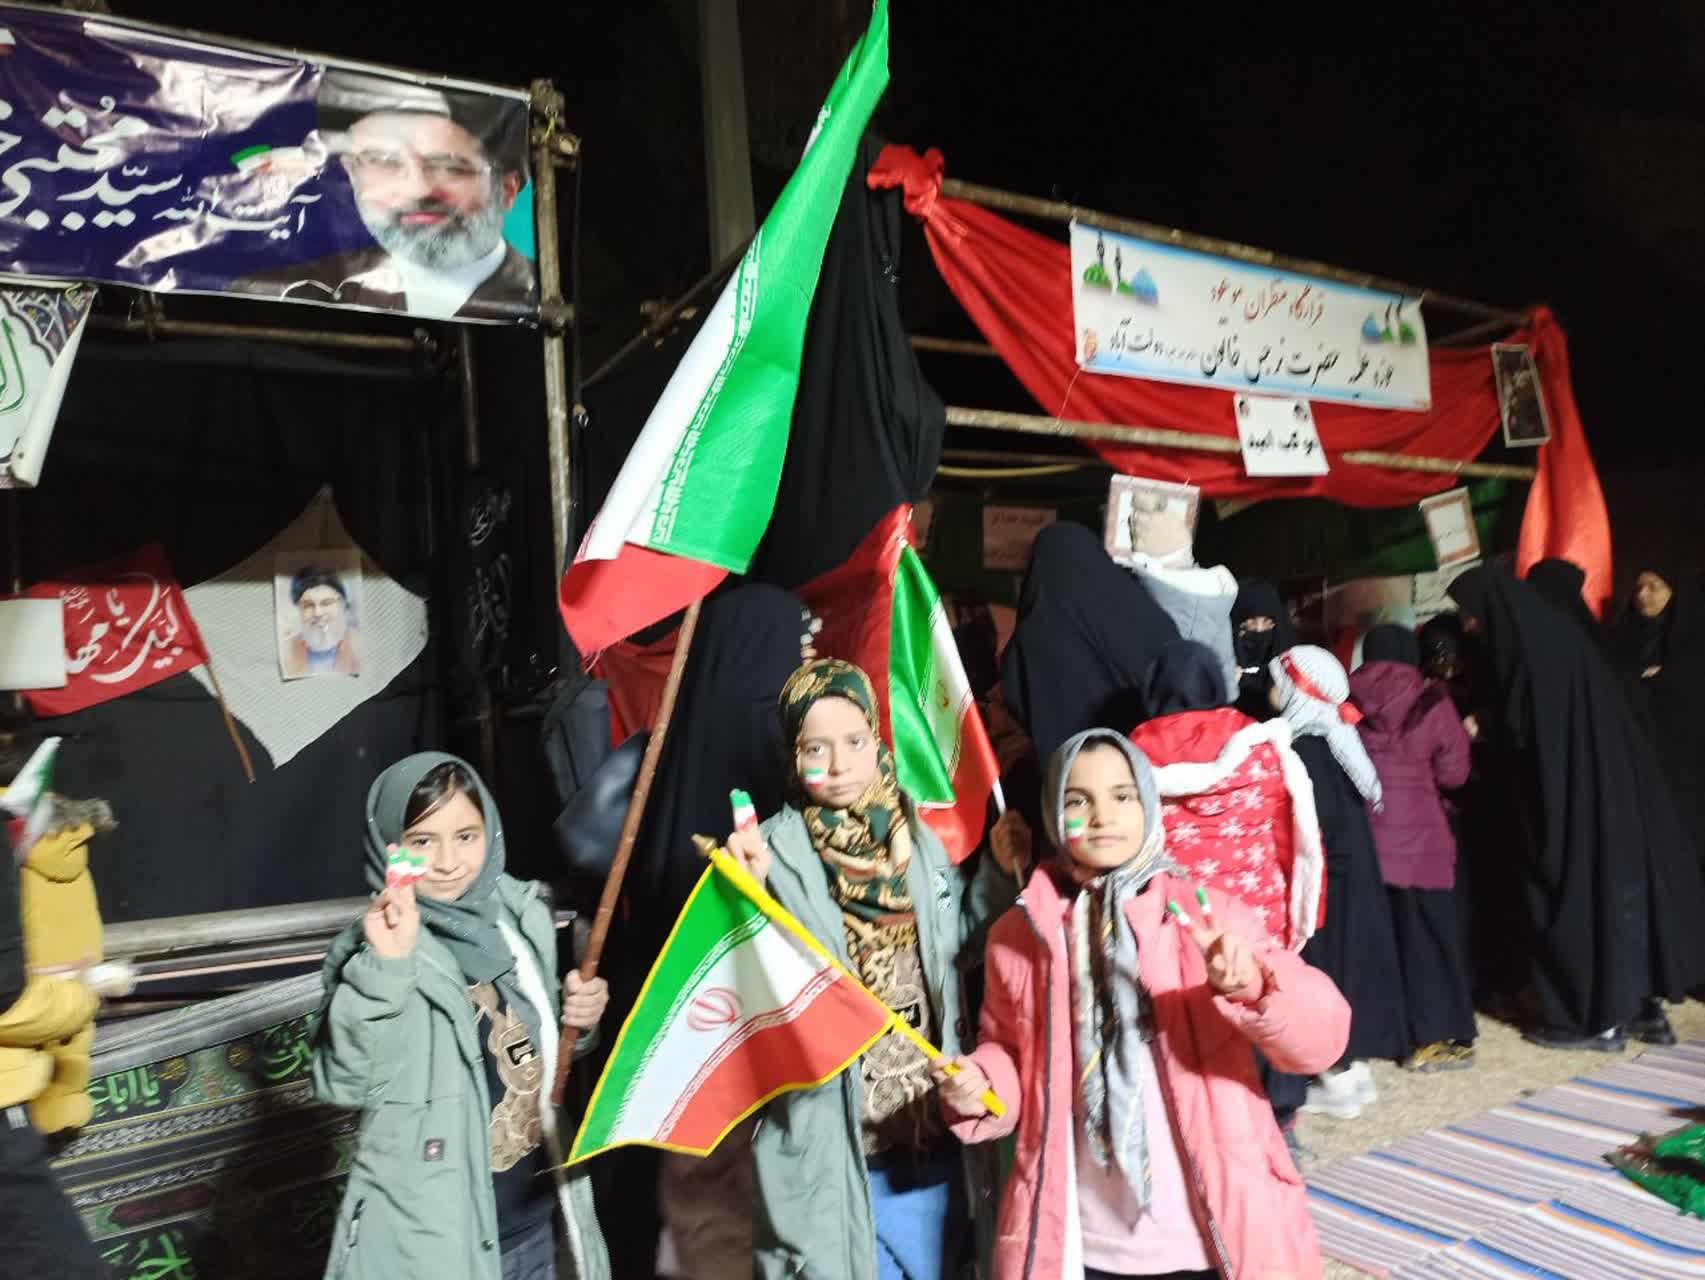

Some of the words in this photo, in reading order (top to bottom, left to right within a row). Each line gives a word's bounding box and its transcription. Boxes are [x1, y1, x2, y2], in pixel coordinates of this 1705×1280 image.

[1200, 316, 1241, 377] خاتون
[1244, 336, 1285, 384] نرجس
[1286, 344, 1341, 387] حضرت
[90, 575, 184, 683] لبیک
[106, 588, 131, 627] یا
